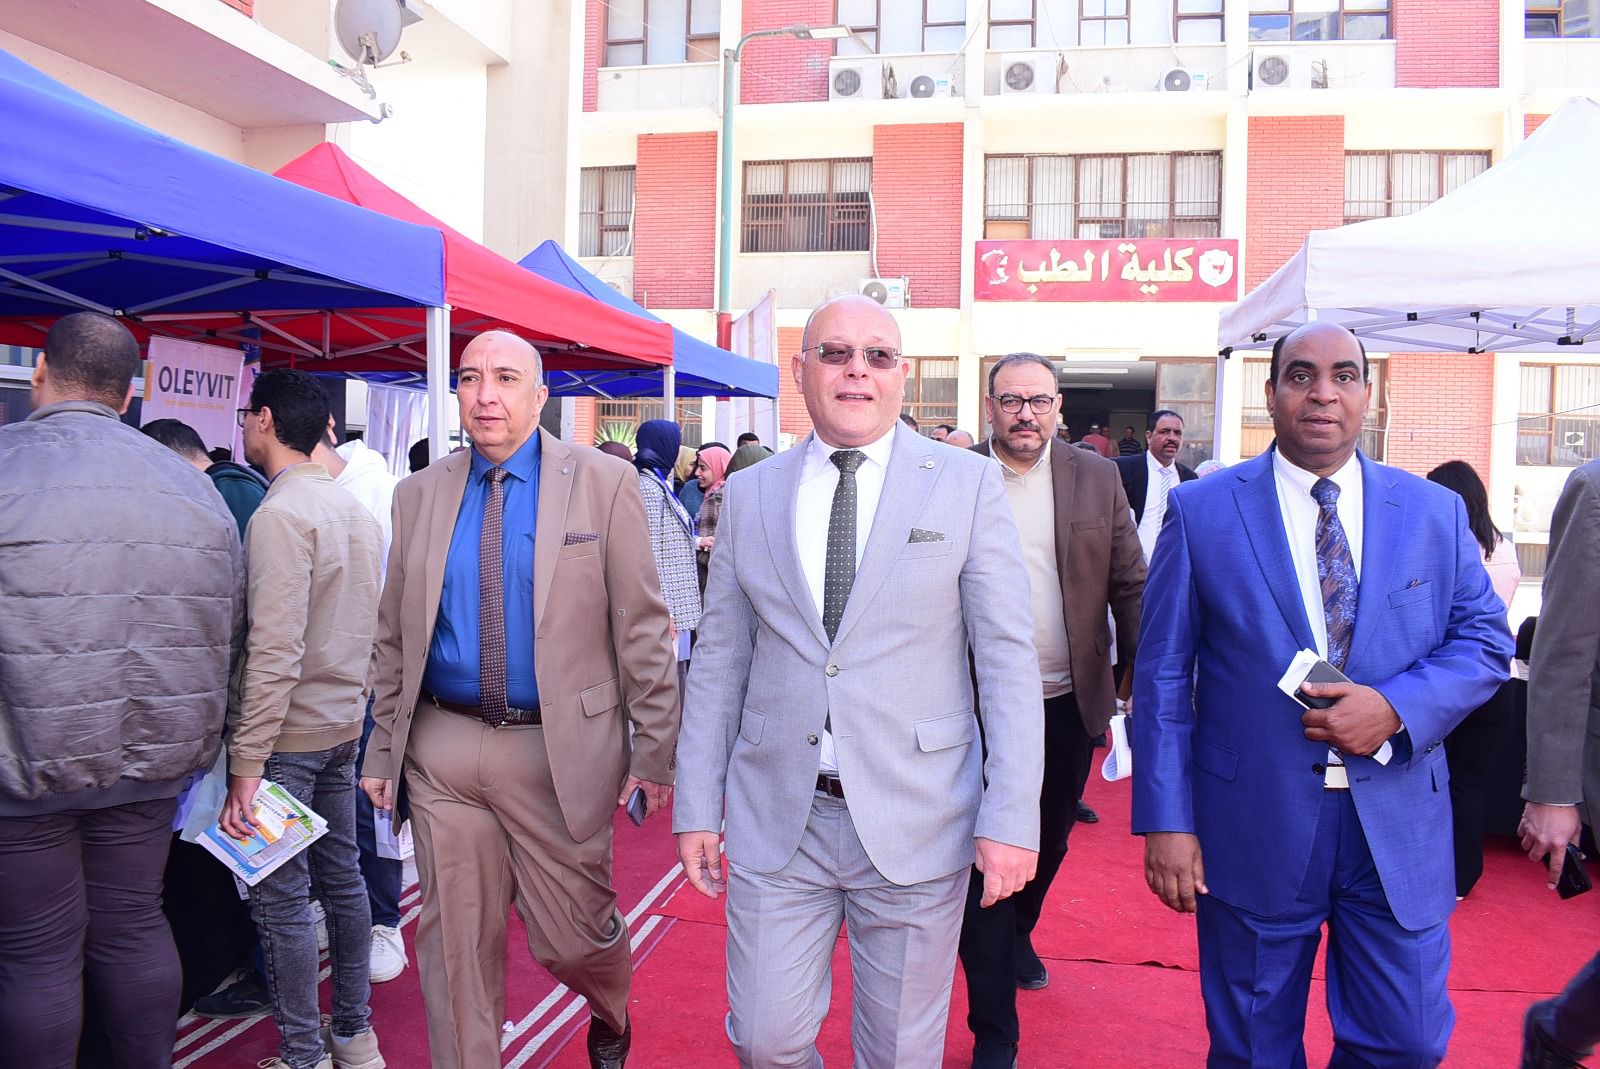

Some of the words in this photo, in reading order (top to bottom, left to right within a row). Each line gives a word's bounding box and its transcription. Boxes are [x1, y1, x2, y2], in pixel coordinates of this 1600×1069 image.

[1017, 248, 1110, 295] الطب
[1118, 242, 1194, 295] كلية
[158, 366, 235, 400] OLEYVIT
